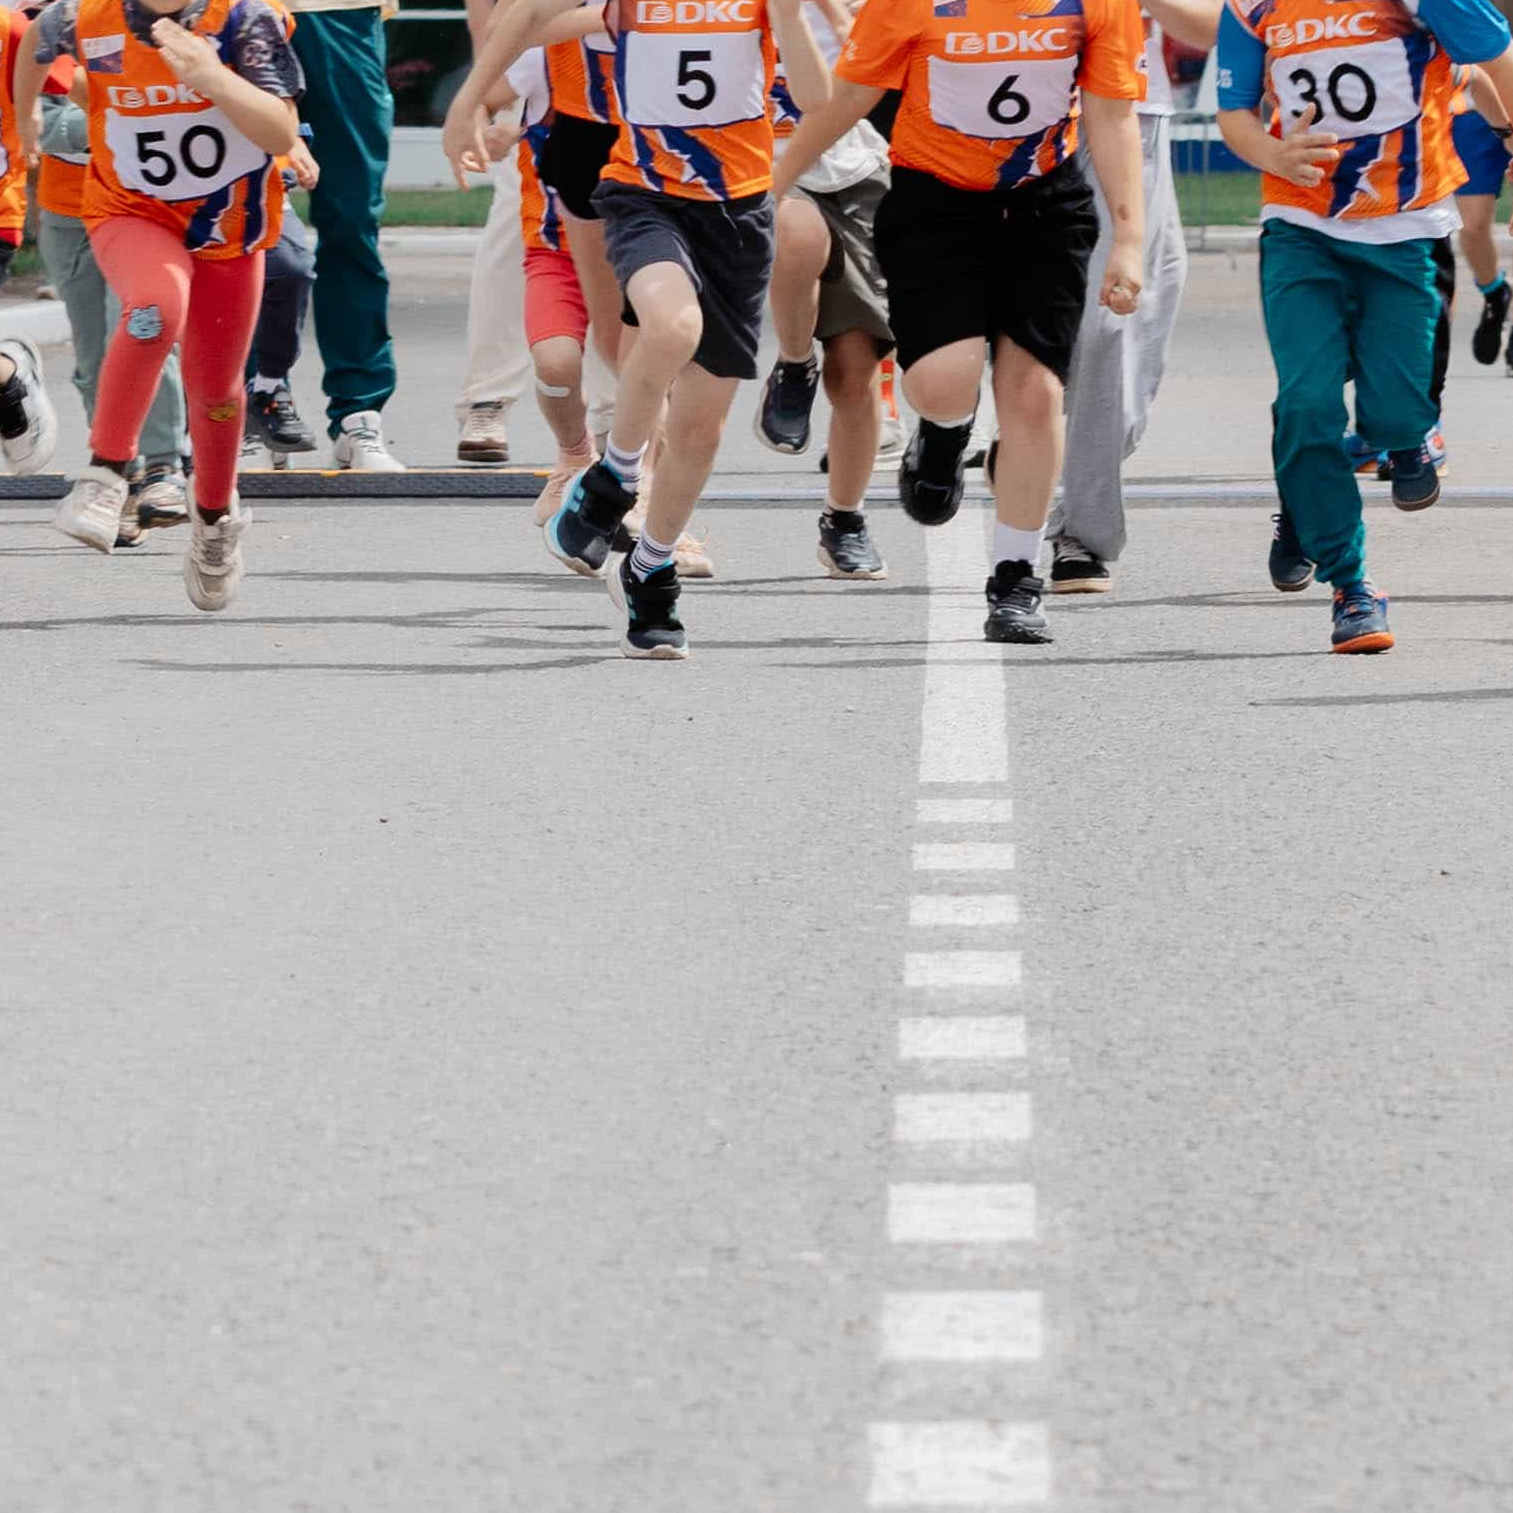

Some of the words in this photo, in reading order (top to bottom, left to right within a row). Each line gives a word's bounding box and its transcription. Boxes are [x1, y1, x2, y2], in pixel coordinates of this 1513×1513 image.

[675, 0, 756, 24] DKC
[1295, 11, 1378, 45] DKC
[987, 27, 1070, 55] DKC
[146, 84, 208, 106] DK
[676, 49, 717, 110] 5
[987, 74, 1031, 125] 6
[1288, 62, 1377, 126] 30
[135, 124, 227, 187] 50
